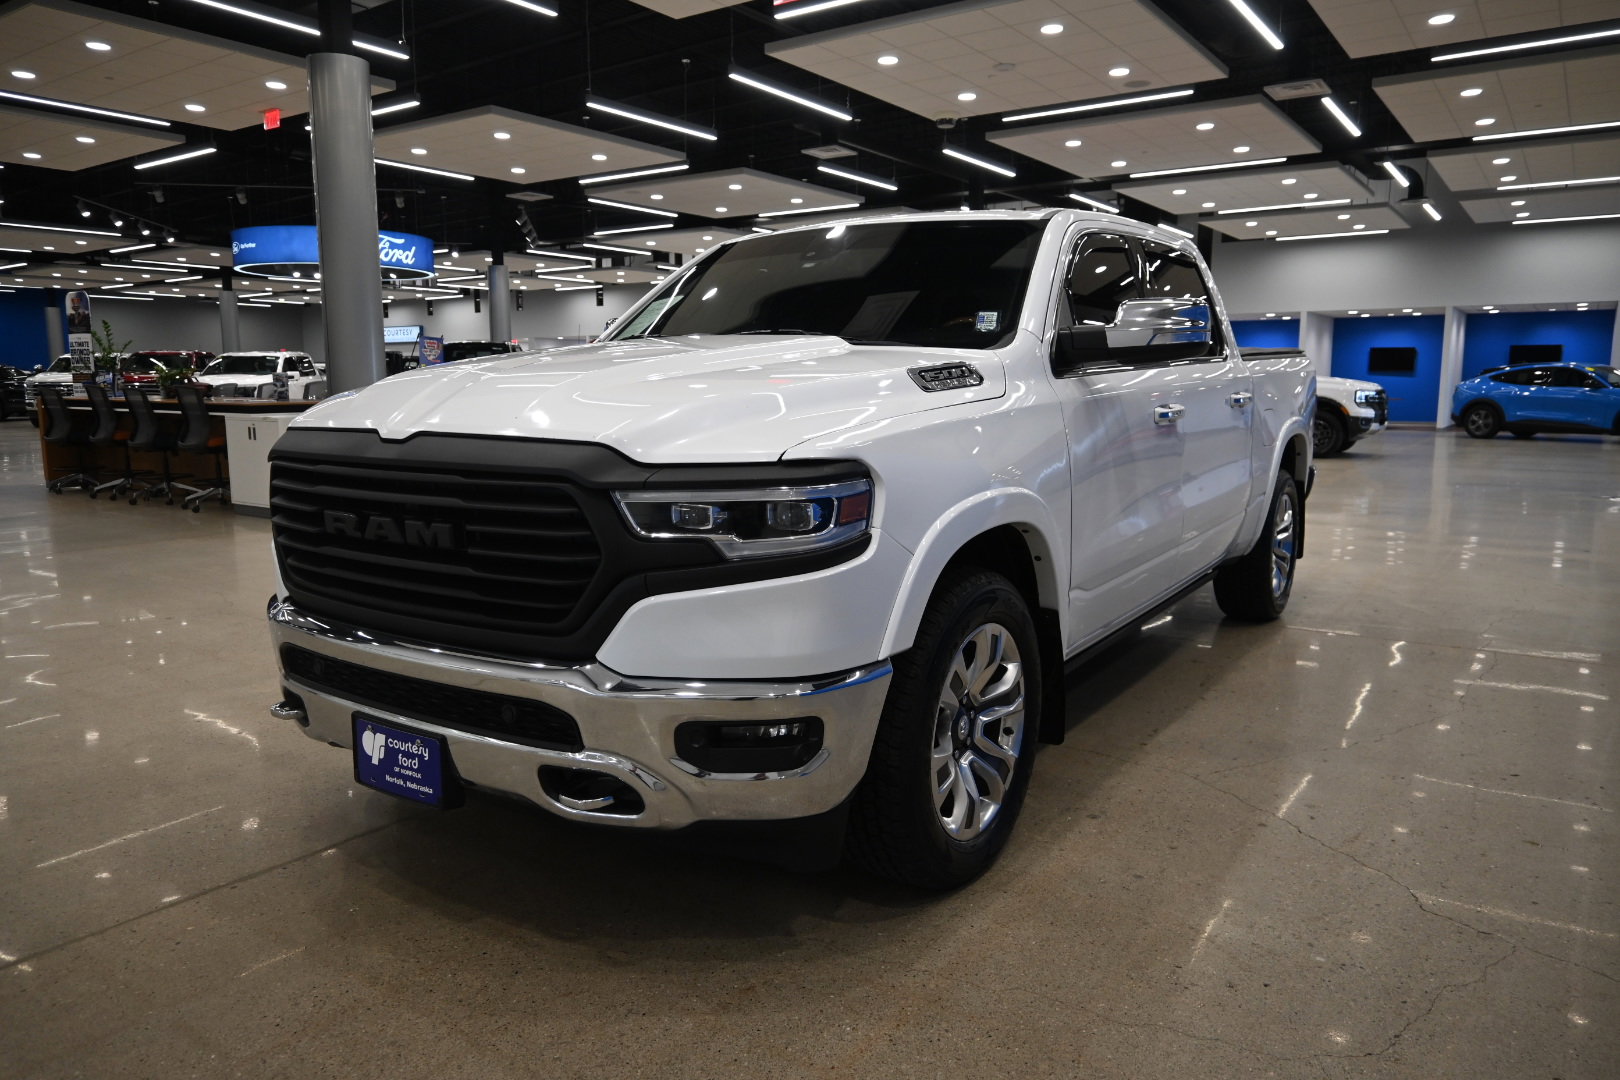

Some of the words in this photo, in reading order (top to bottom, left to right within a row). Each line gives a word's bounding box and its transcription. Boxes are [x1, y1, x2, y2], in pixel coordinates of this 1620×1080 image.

[378, 234, 416, 265] Ford
[920, 367, 970, 382] 1500
[323, 509, 454, 550] RAM
[387, 738, 429, 761] courtesy
[398, 753, 419, 769] ford
[400, 768, 422, 779] NORFOLK
[385, 774, 406, 787] Norfolk,
[406, 781, 433, 794] Nebraska
